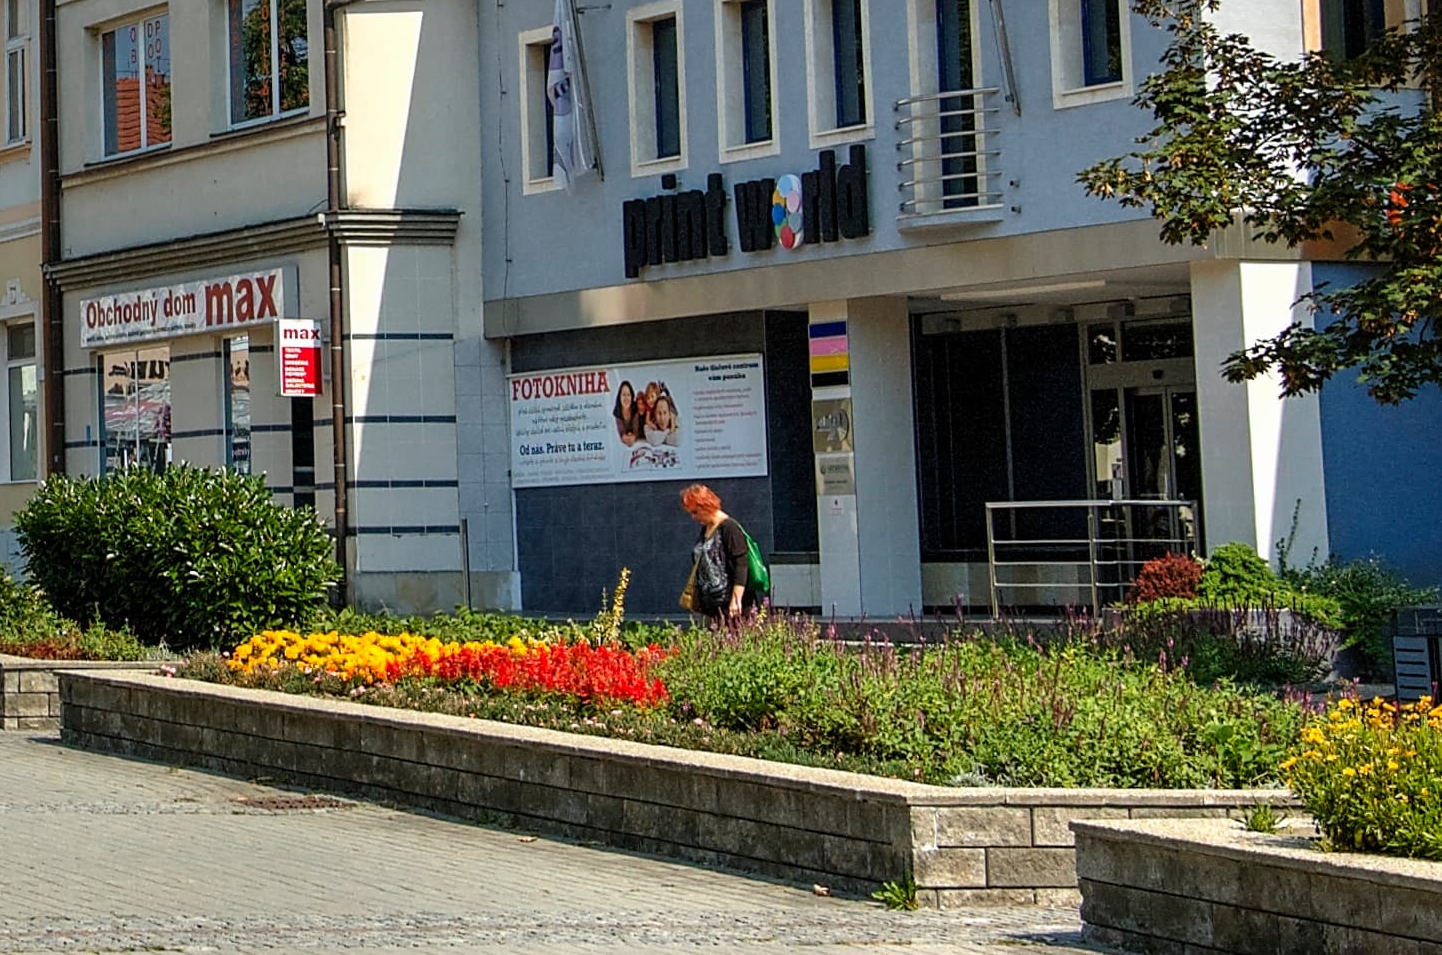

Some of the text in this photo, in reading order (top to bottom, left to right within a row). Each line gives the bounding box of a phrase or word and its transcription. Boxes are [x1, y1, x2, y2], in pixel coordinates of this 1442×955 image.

[623, 144, 869, 278] print world
[86, 274, 278, 329] Obchodný dom max
[283, 328, 321, 340] max
[512, 371, 610, 401] FOTOKNIHA
[519, 444, 530, 456] Od
[531, 443, 545, 455] nás.
[546, 442, 567, 454] Práve
[568, 442, 575, 453] tu
[583, 441, 605, 451] teraz.
